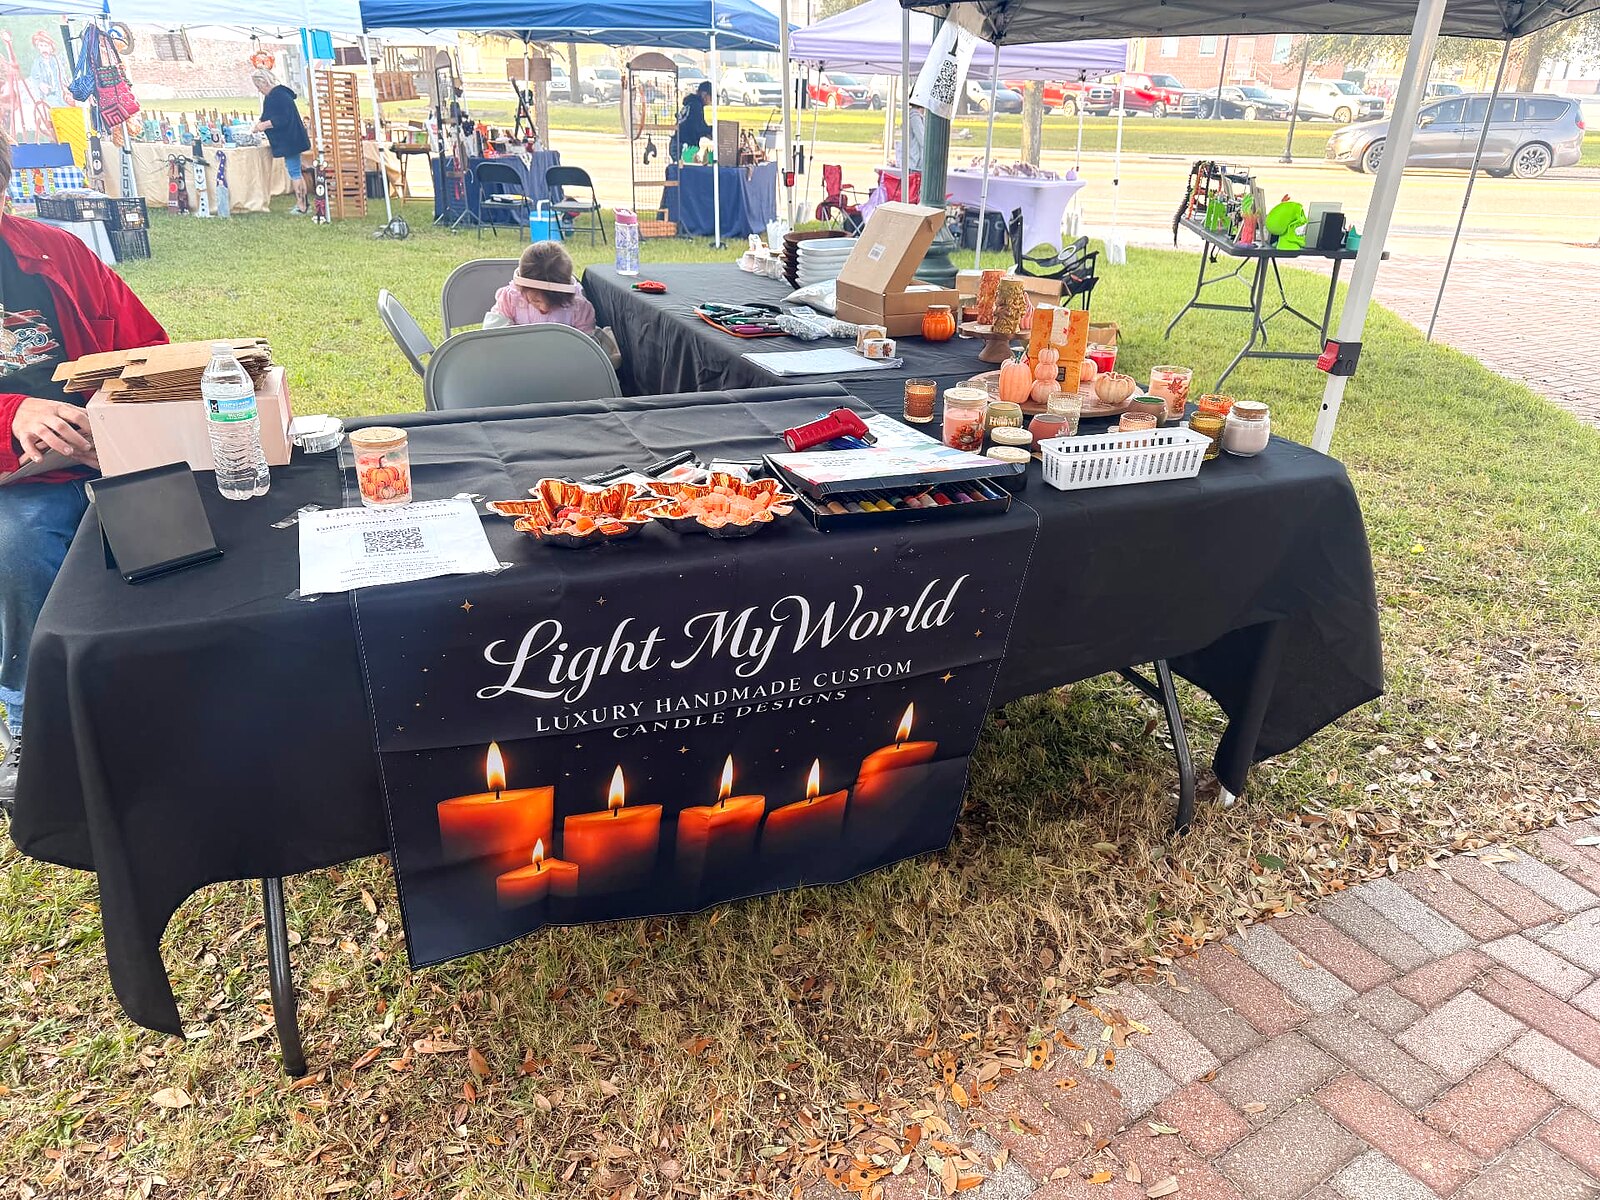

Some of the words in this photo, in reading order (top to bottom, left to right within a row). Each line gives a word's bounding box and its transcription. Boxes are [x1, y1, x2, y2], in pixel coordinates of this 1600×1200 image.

[476, 619, 666, 704] Light
[670, 608, 784, 678] My
[770, 573, 970, 654] World
[535, 701, 645, 733] LUXURY
[655, 677, 802, 714] HANDMADE
[812, 659, 913, 688] CUSTOM
[612, 712, 726, 740] CANDLE
[735, 690, 848, 718] DESIGNS
